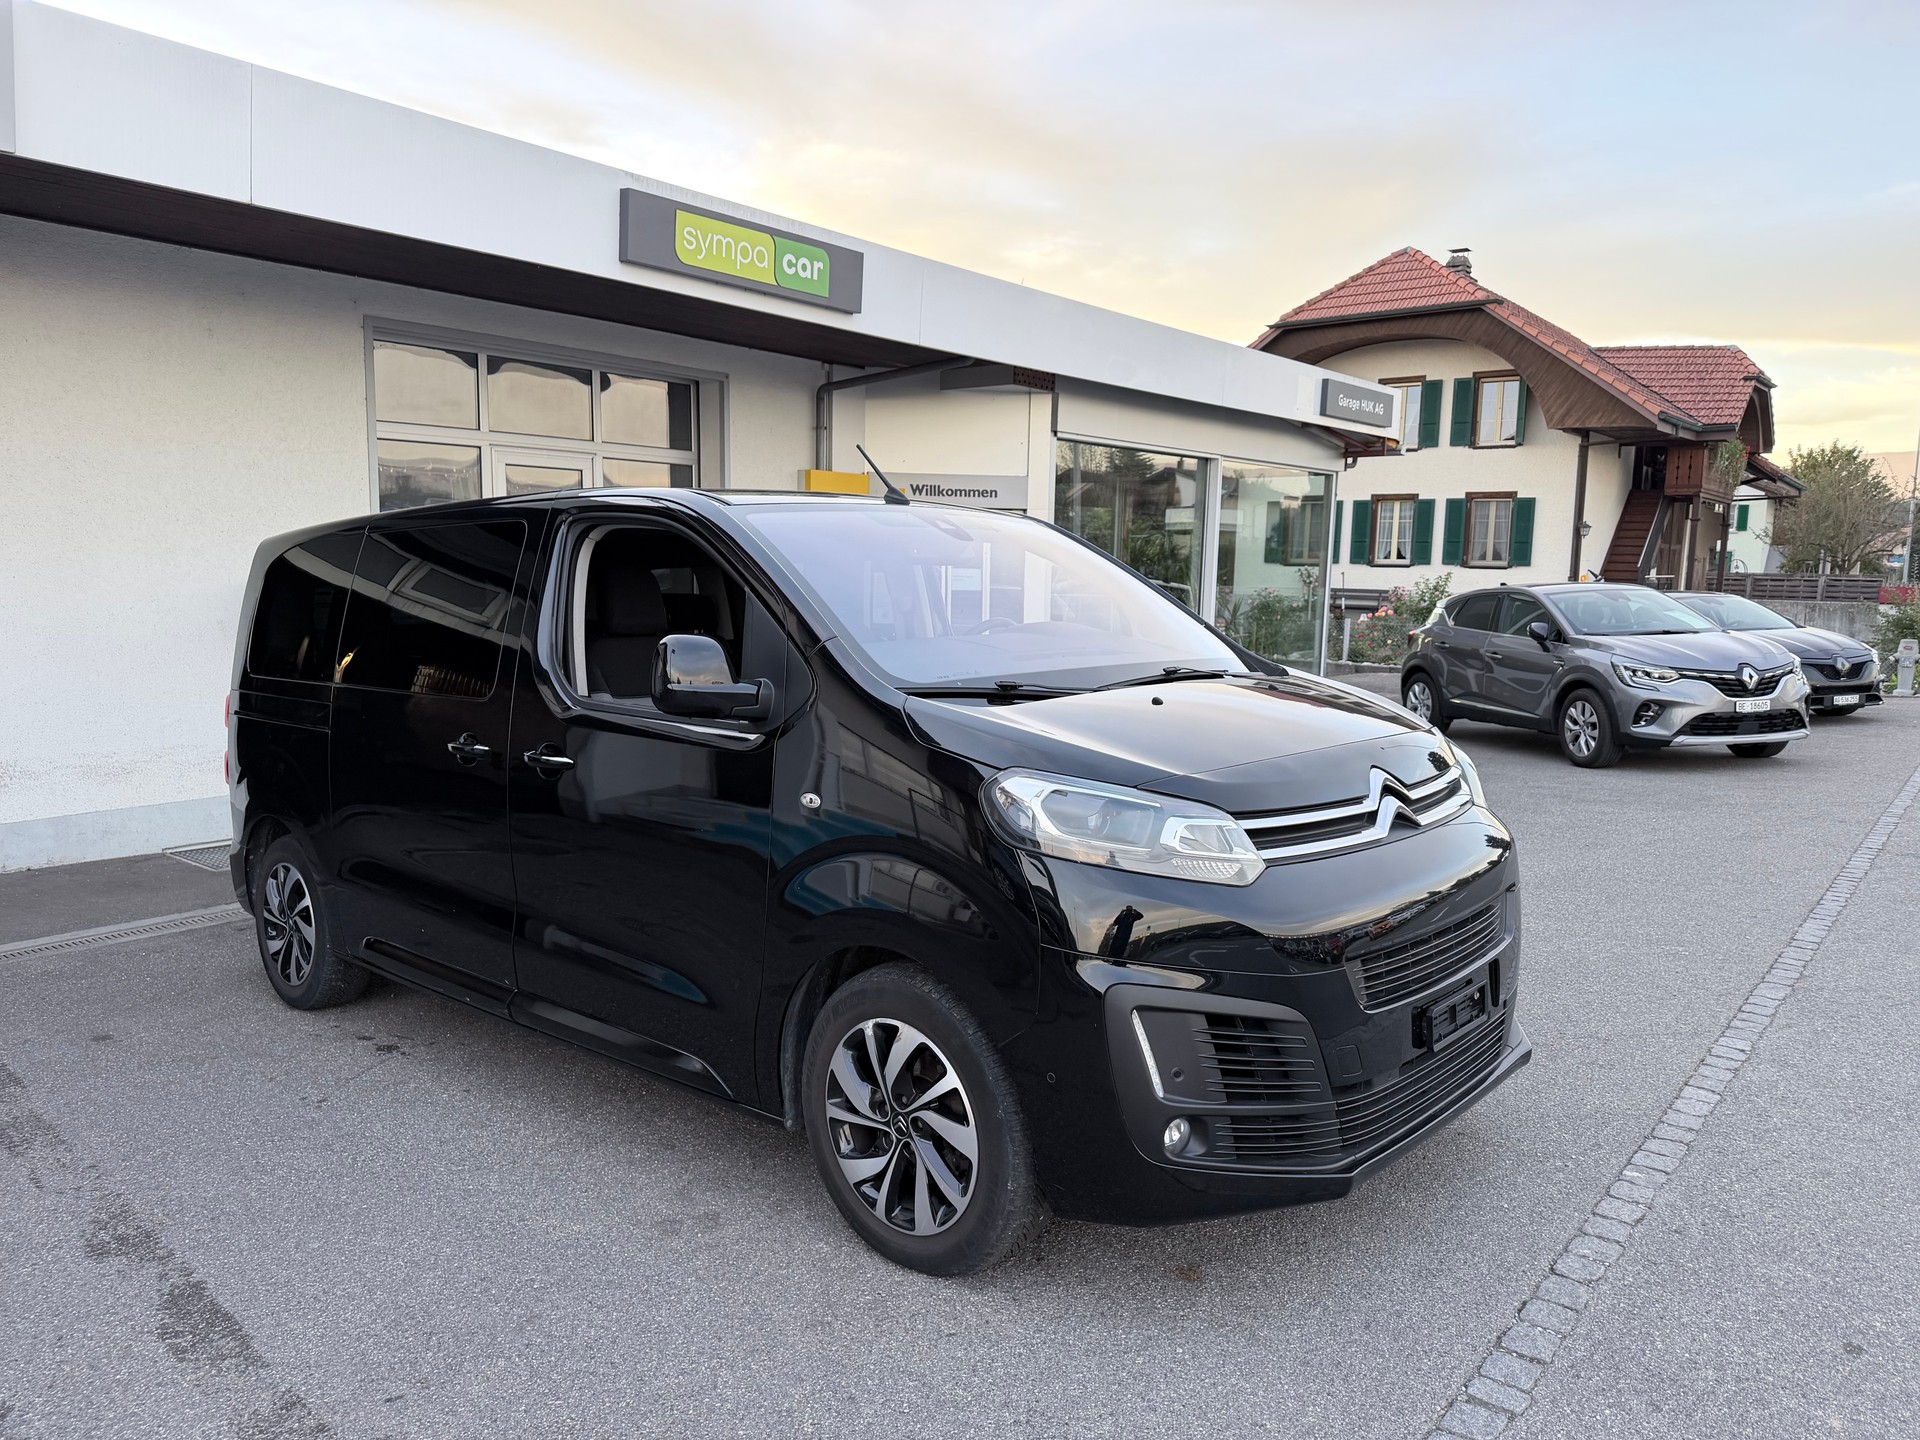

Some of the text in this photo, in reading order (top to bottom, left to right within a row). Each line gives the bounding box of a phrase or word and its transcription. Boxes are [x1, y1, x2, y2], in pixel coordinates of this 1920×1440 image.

[683, 226, 824, 281] sympa car
[1338, 394, 1384, 415] Garage HUK AG
[909, 483, 998, 499] Willkommen
